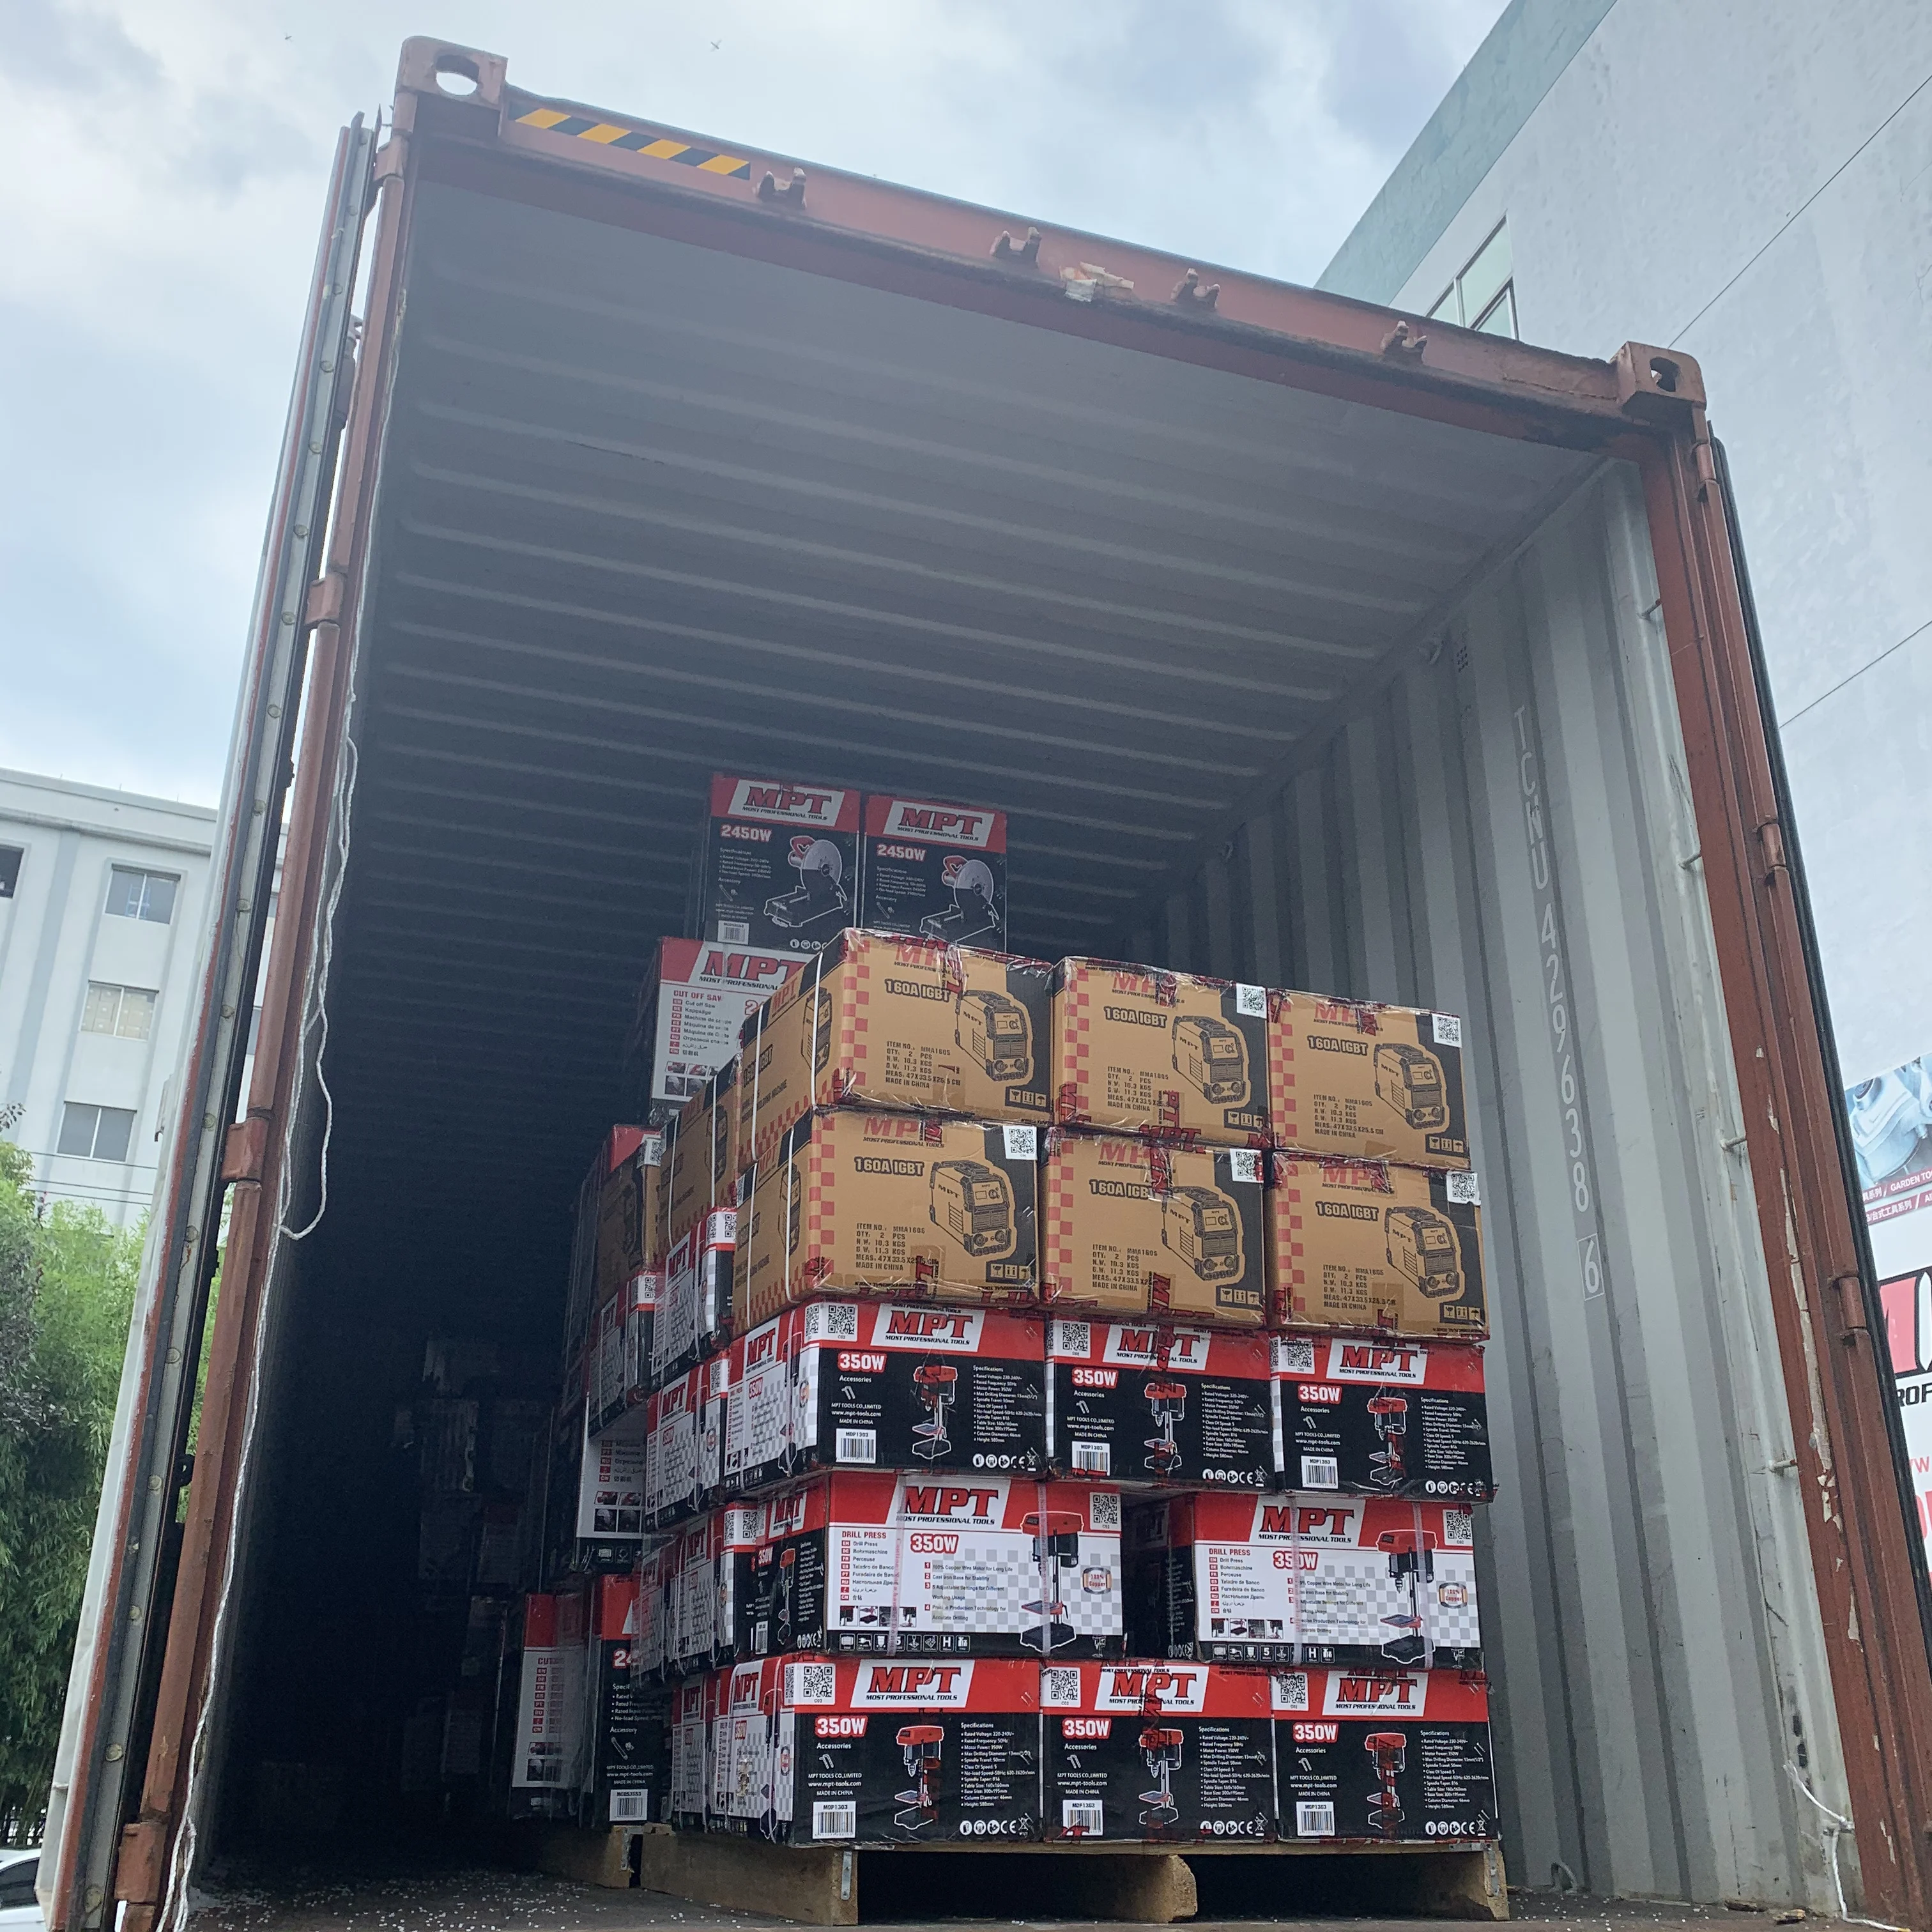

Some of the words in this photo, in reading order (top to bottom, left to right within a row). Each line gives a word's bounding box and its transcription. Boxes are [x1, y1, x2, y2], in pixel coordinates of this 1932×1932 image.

[745, 786, 831, 814] MPT
[760, 809, 806, 818] PROFESSIONAL
[898, 807, 983, 835] MPT
[720, 824, 772, 843] 2450W
[914, 829, 958, 839] PROFESSIONAL
[877, 843, 926, 861] 2450W
[884, 978, 919, 997] 160A
[921, 984, 951, 1002] IGBT
[963, 1011, 983, 1026] MPT
[1104, 1006, 1137, 1023] 160A
[1139, 1011, 1167, 1028] IGBT
[1179, 1036, 1199, 1050] MPT
[1307, 1035, 1340, 1052] 160A
[1342, 1039, 1368, 1055] IGBT
[864, 1117, 919, 1137] MP
[880, 1137, 924, 1147] PROFESSIONAL
[854, 1156, 892, 1174] 160A
[893, 1160, 924, 1176] IGBT
[938, 1184, 960, 1199] MPT
[1089, 1179, 1126, 1197] 160A
[1127, 1183, 1152, 1199] IGB
[1890, 1174, 1920, 1192] GARDEN
[1920, 1170, 1932, 1181] TO
[1170, 1208, 1190, 1224] MPT
[1315, 1201, 1351, 1218] 160A
[1351, 1204, 1379, 1221] IGBT
[1392, 1229, 1412, 1243] MPT
[1584, 1240, 1599, 1294] 6
[887, 1310, 973, 1338] MPT
[838, 1352, 887, 1373] 350W
[1340, 1345, 1418, 1372] MPT
[1072, 1367, 1117, 1388] 350W
[1298, 1384, 1341, 1404] 350W
[897, 1486, 998, 1517] MPT
[1259, 1505, 1354, 1535] MPT
[910, 1533, 959, 1554] 350W
[867, 1667, 961, 1693] MPT
[1110, 1672, 1197, 1698] MPT
[1337, 1678, 1418, 1703] MPT
[815, 1716, 868, 1737] 350W
[1062, 1718, 1111, 1739] 350W
[1293, 1722, 1338, 1743] 350W
